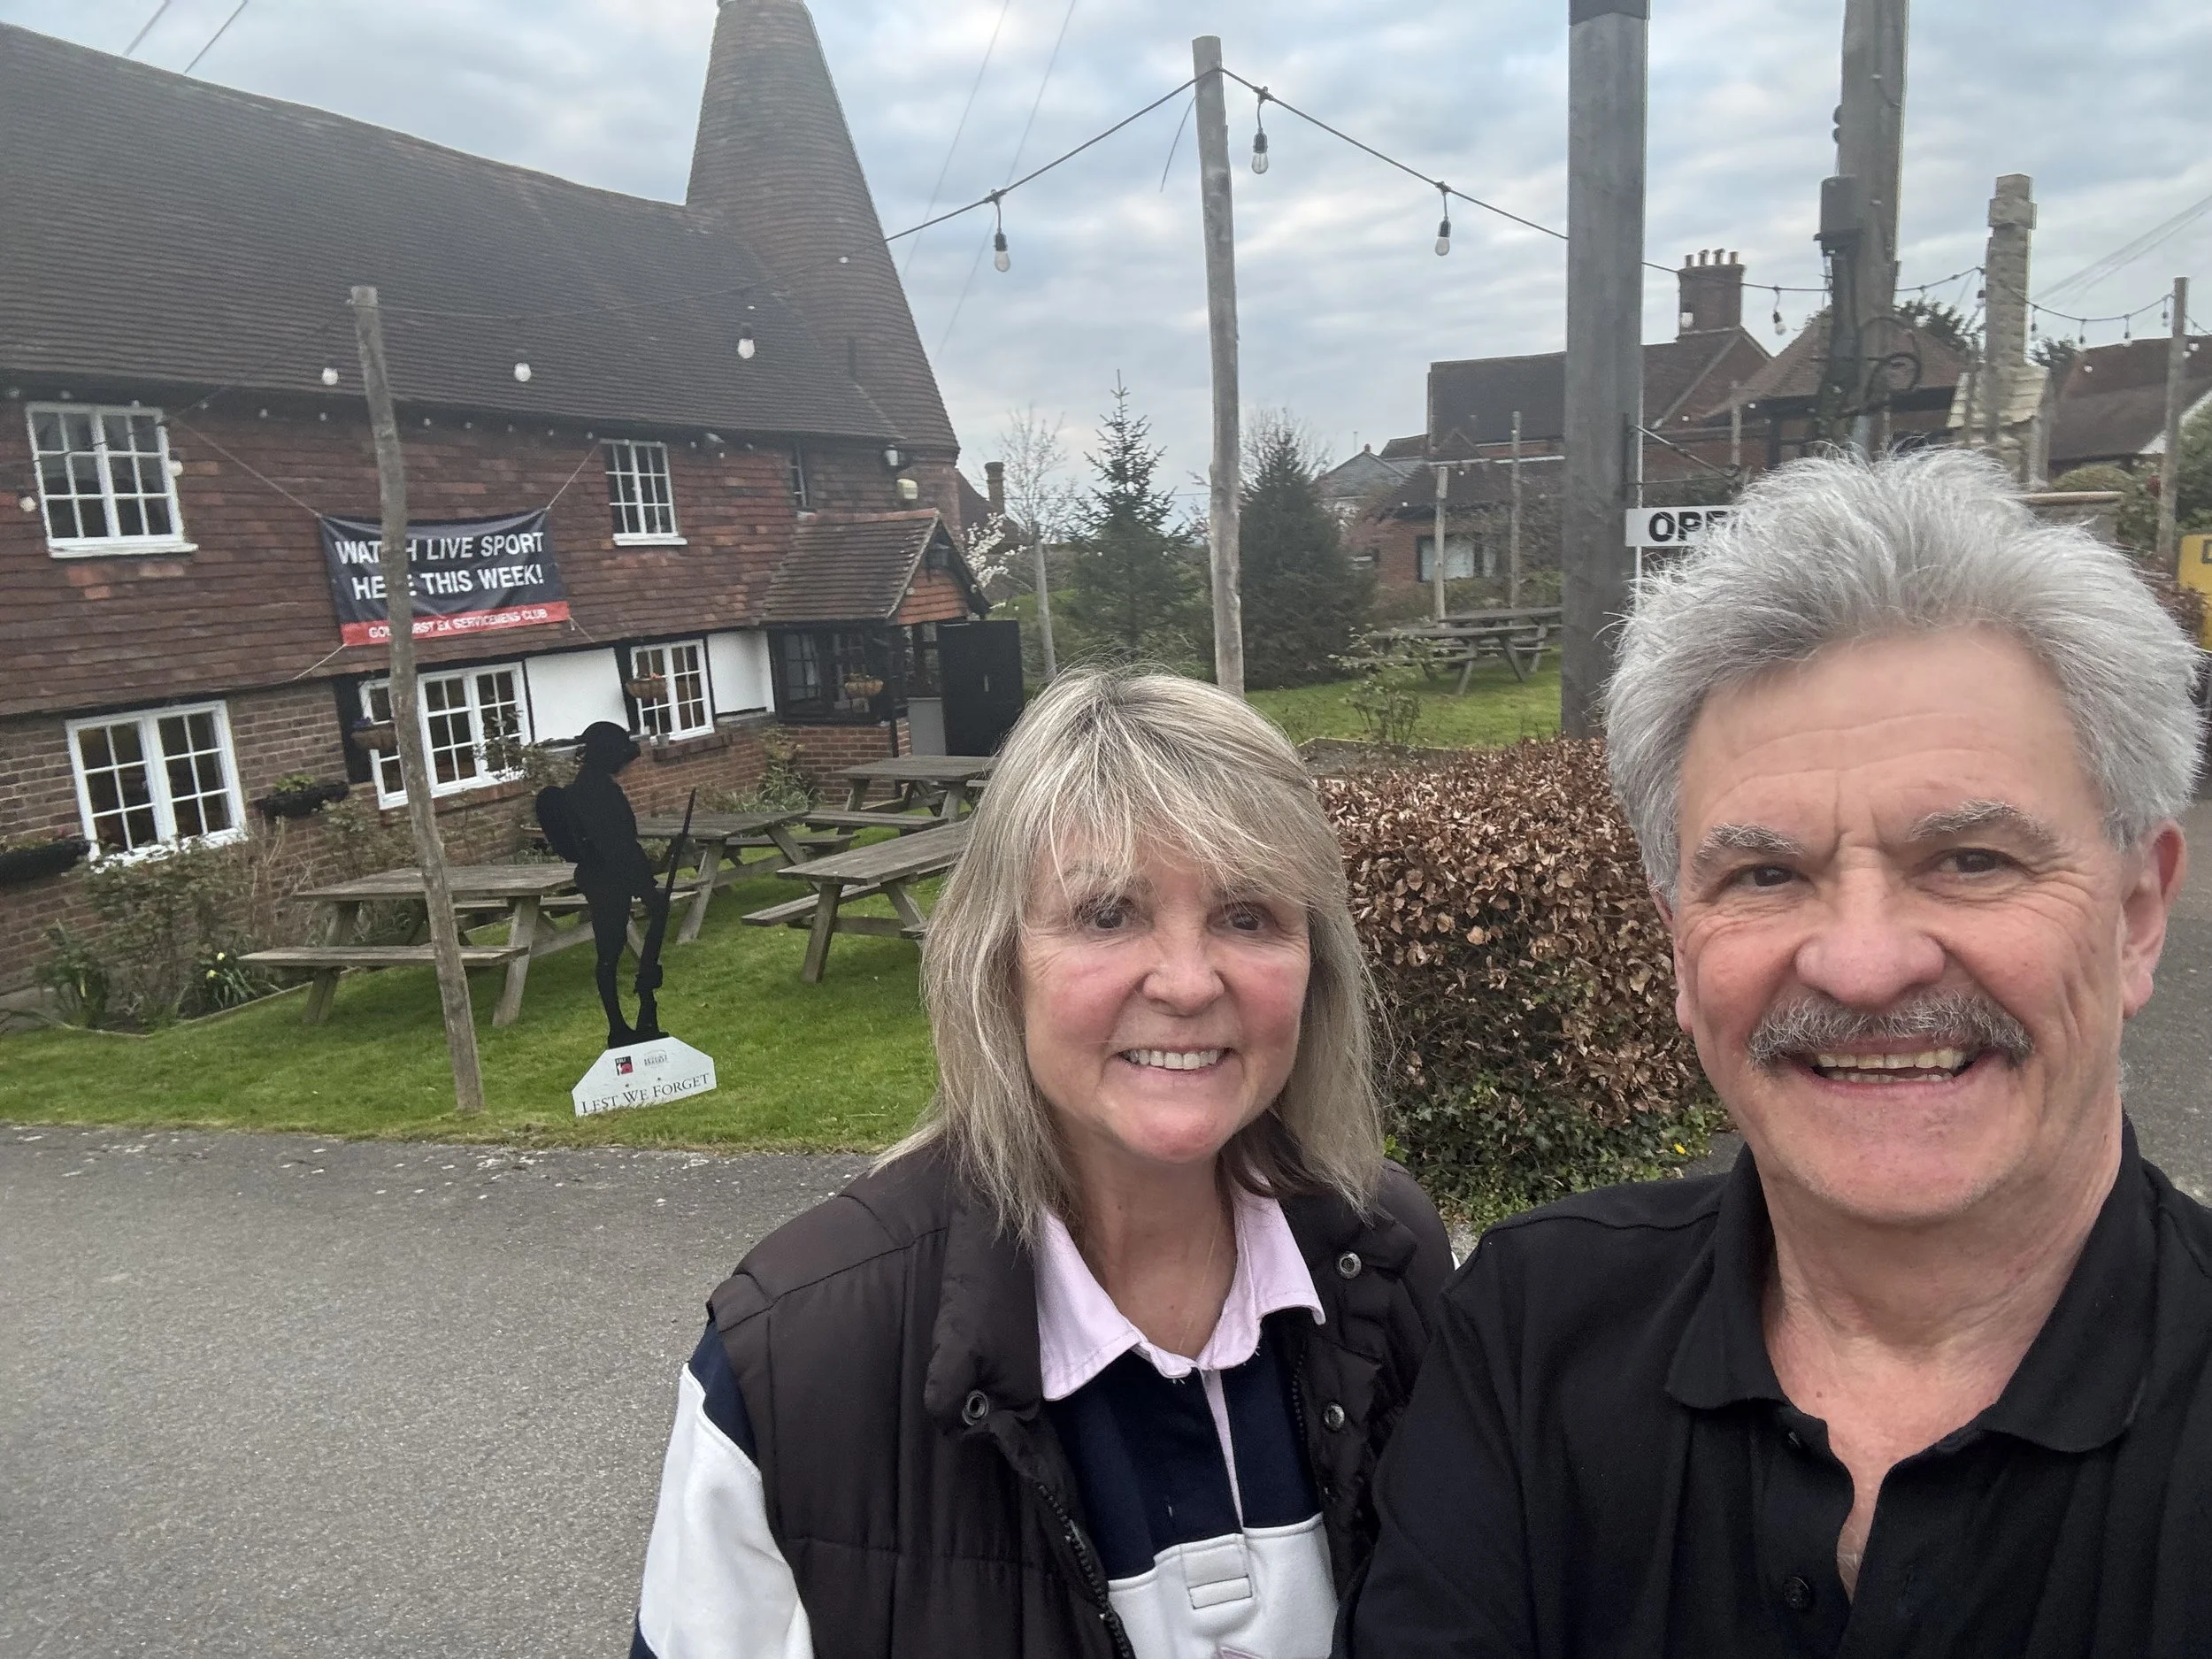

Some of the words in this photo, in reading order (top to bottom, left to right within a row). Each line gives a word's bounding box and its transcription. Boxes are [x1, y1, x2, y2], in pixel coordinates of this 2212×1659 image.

[335, 539, 418, 565] WATH
[426, 536, 473, 560] LIVE
[480, 532, 543, 557] SPORT
[351, 574, 418, 600] HE
[420, 570, 473, 595] THIS
[477, 564, 544, 590] WEEK!
[521, 608, 548, 620] CLUB
[581, 1094, 618, 1114] LEST
[623, 1089, 648, 1102] WE
[652, 1072, 709, 1098] FORGET
